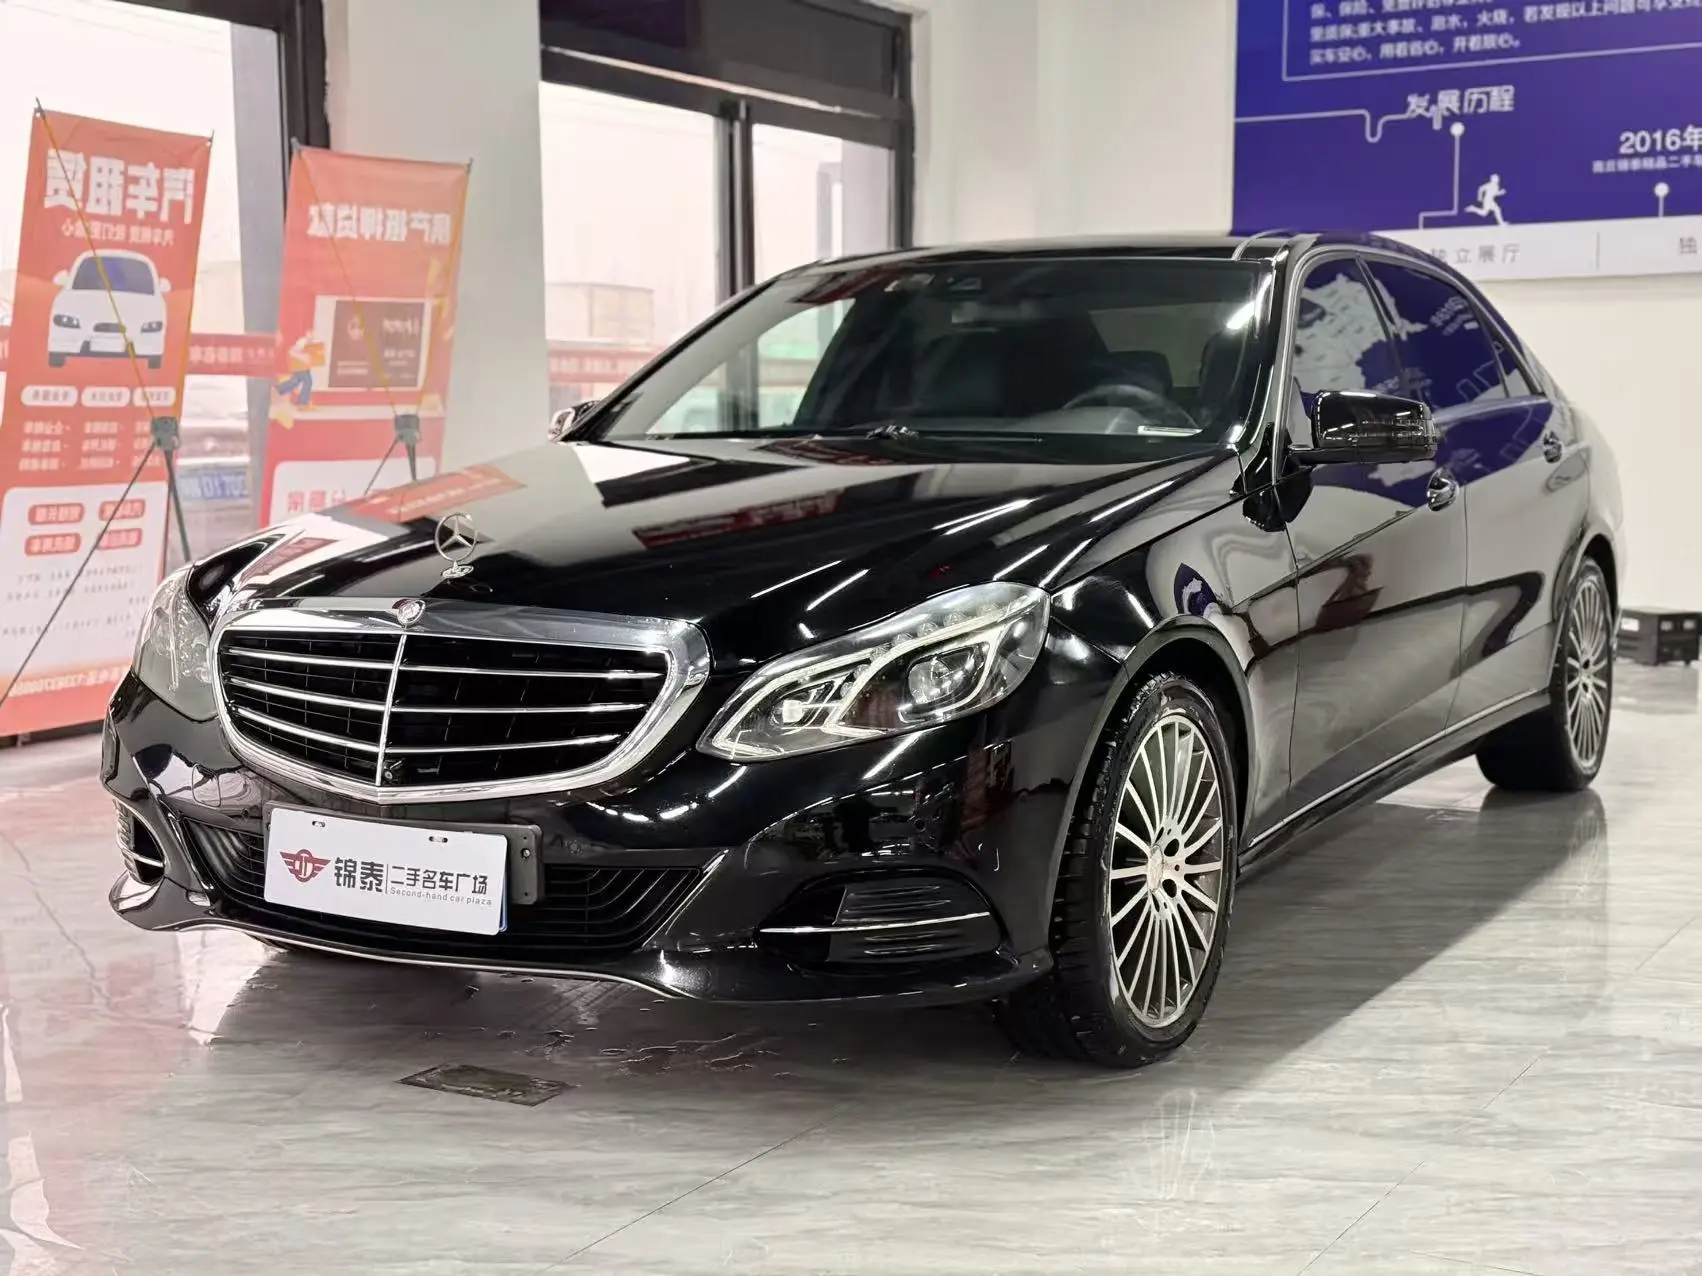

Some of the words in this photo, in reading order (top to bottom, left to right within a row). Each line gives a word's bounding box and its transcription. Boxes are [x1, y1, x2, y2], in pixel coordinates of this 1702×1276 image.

[1406, 85, 1515, 129] 发展历程
[1620, 123, 1702, 154] 2016年
[334, 856, 384, 893] 锦泰
[391, 865, 489, 895] 二手名车广场
[390, 886, 448, 902] Second-hand
[449, 895, 465, 903] car
[466, 896, 493, 907] plaza
